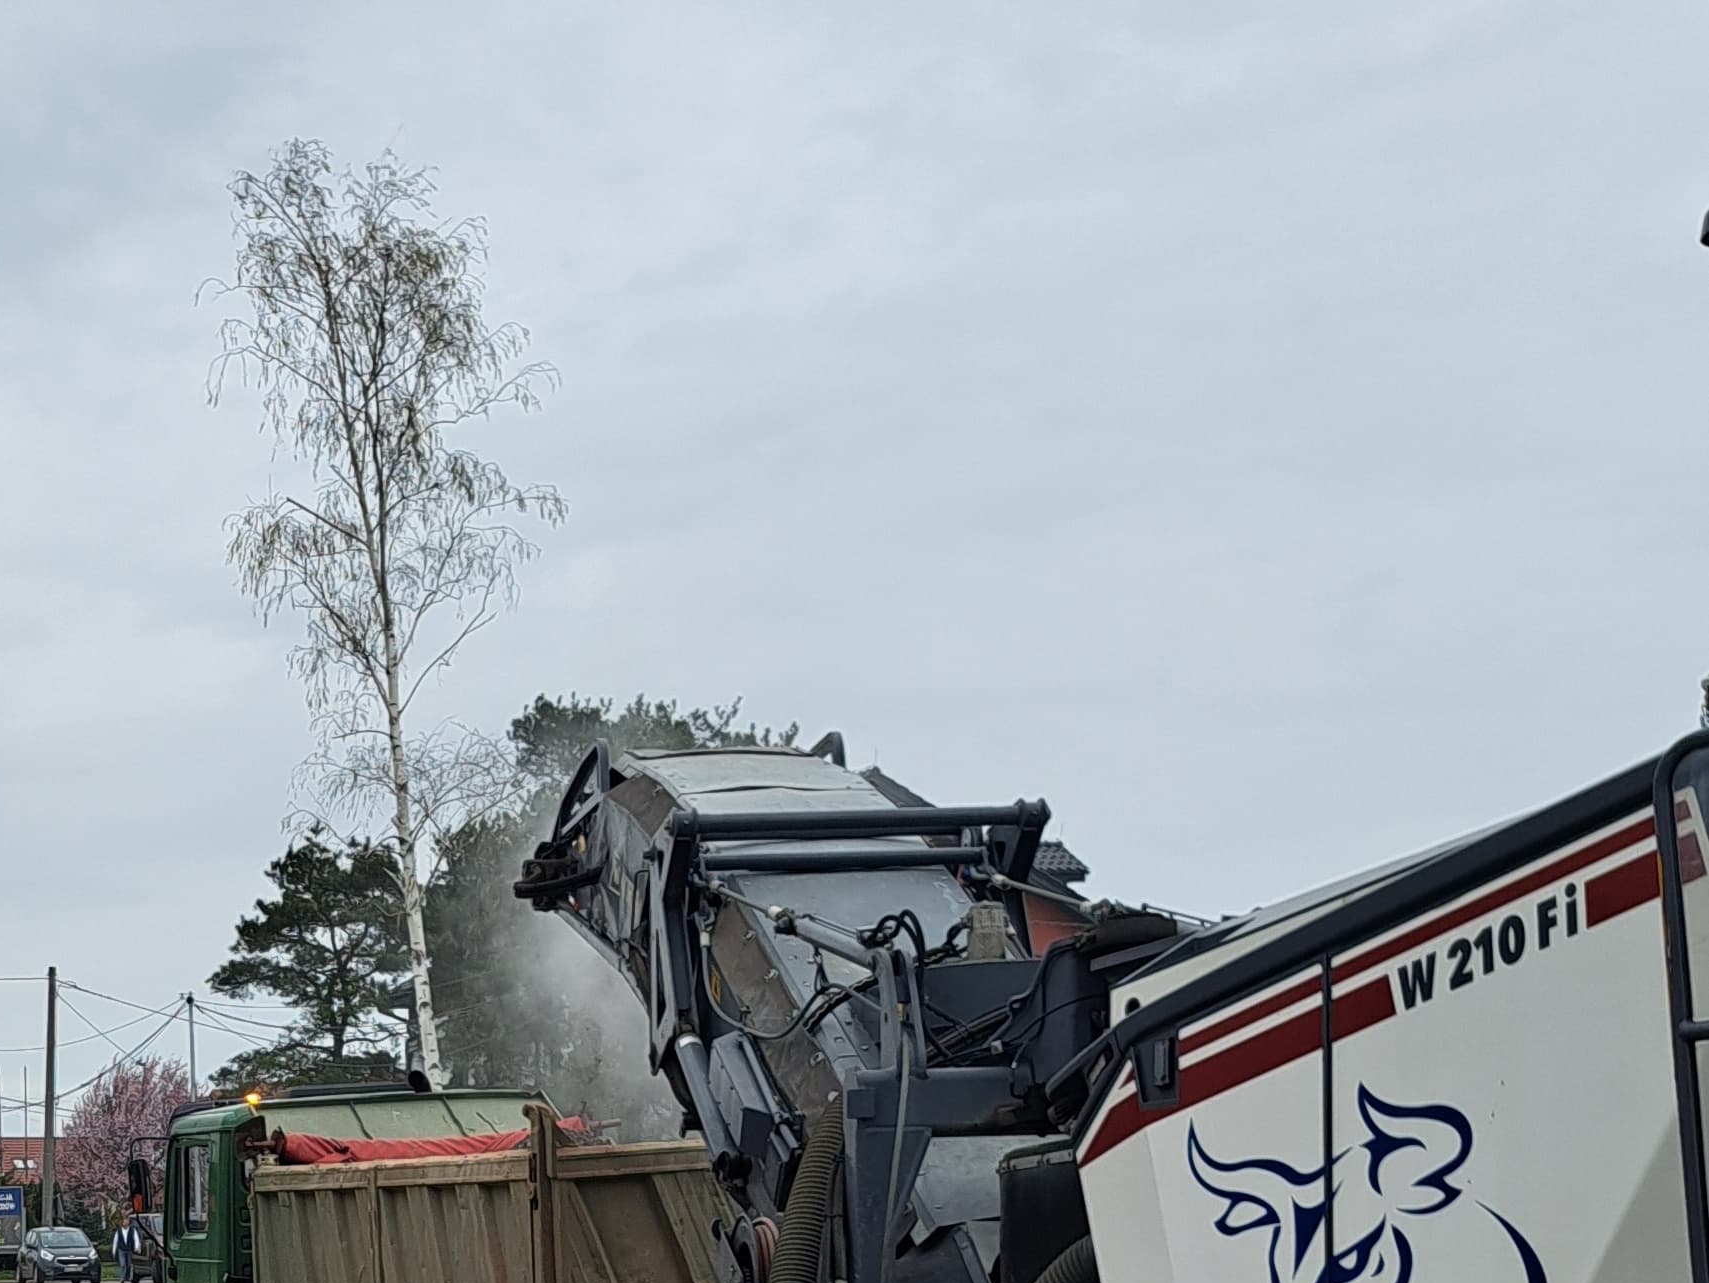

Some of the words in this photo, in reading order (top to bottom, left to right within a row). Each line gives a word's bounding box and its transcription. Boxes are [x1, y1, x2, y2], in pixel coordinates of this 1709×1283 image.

[1397, 951, 1436, 1011] W
[1447, 914, 1526, 991] 210
[1536, 882, 1578, 950] Fi
